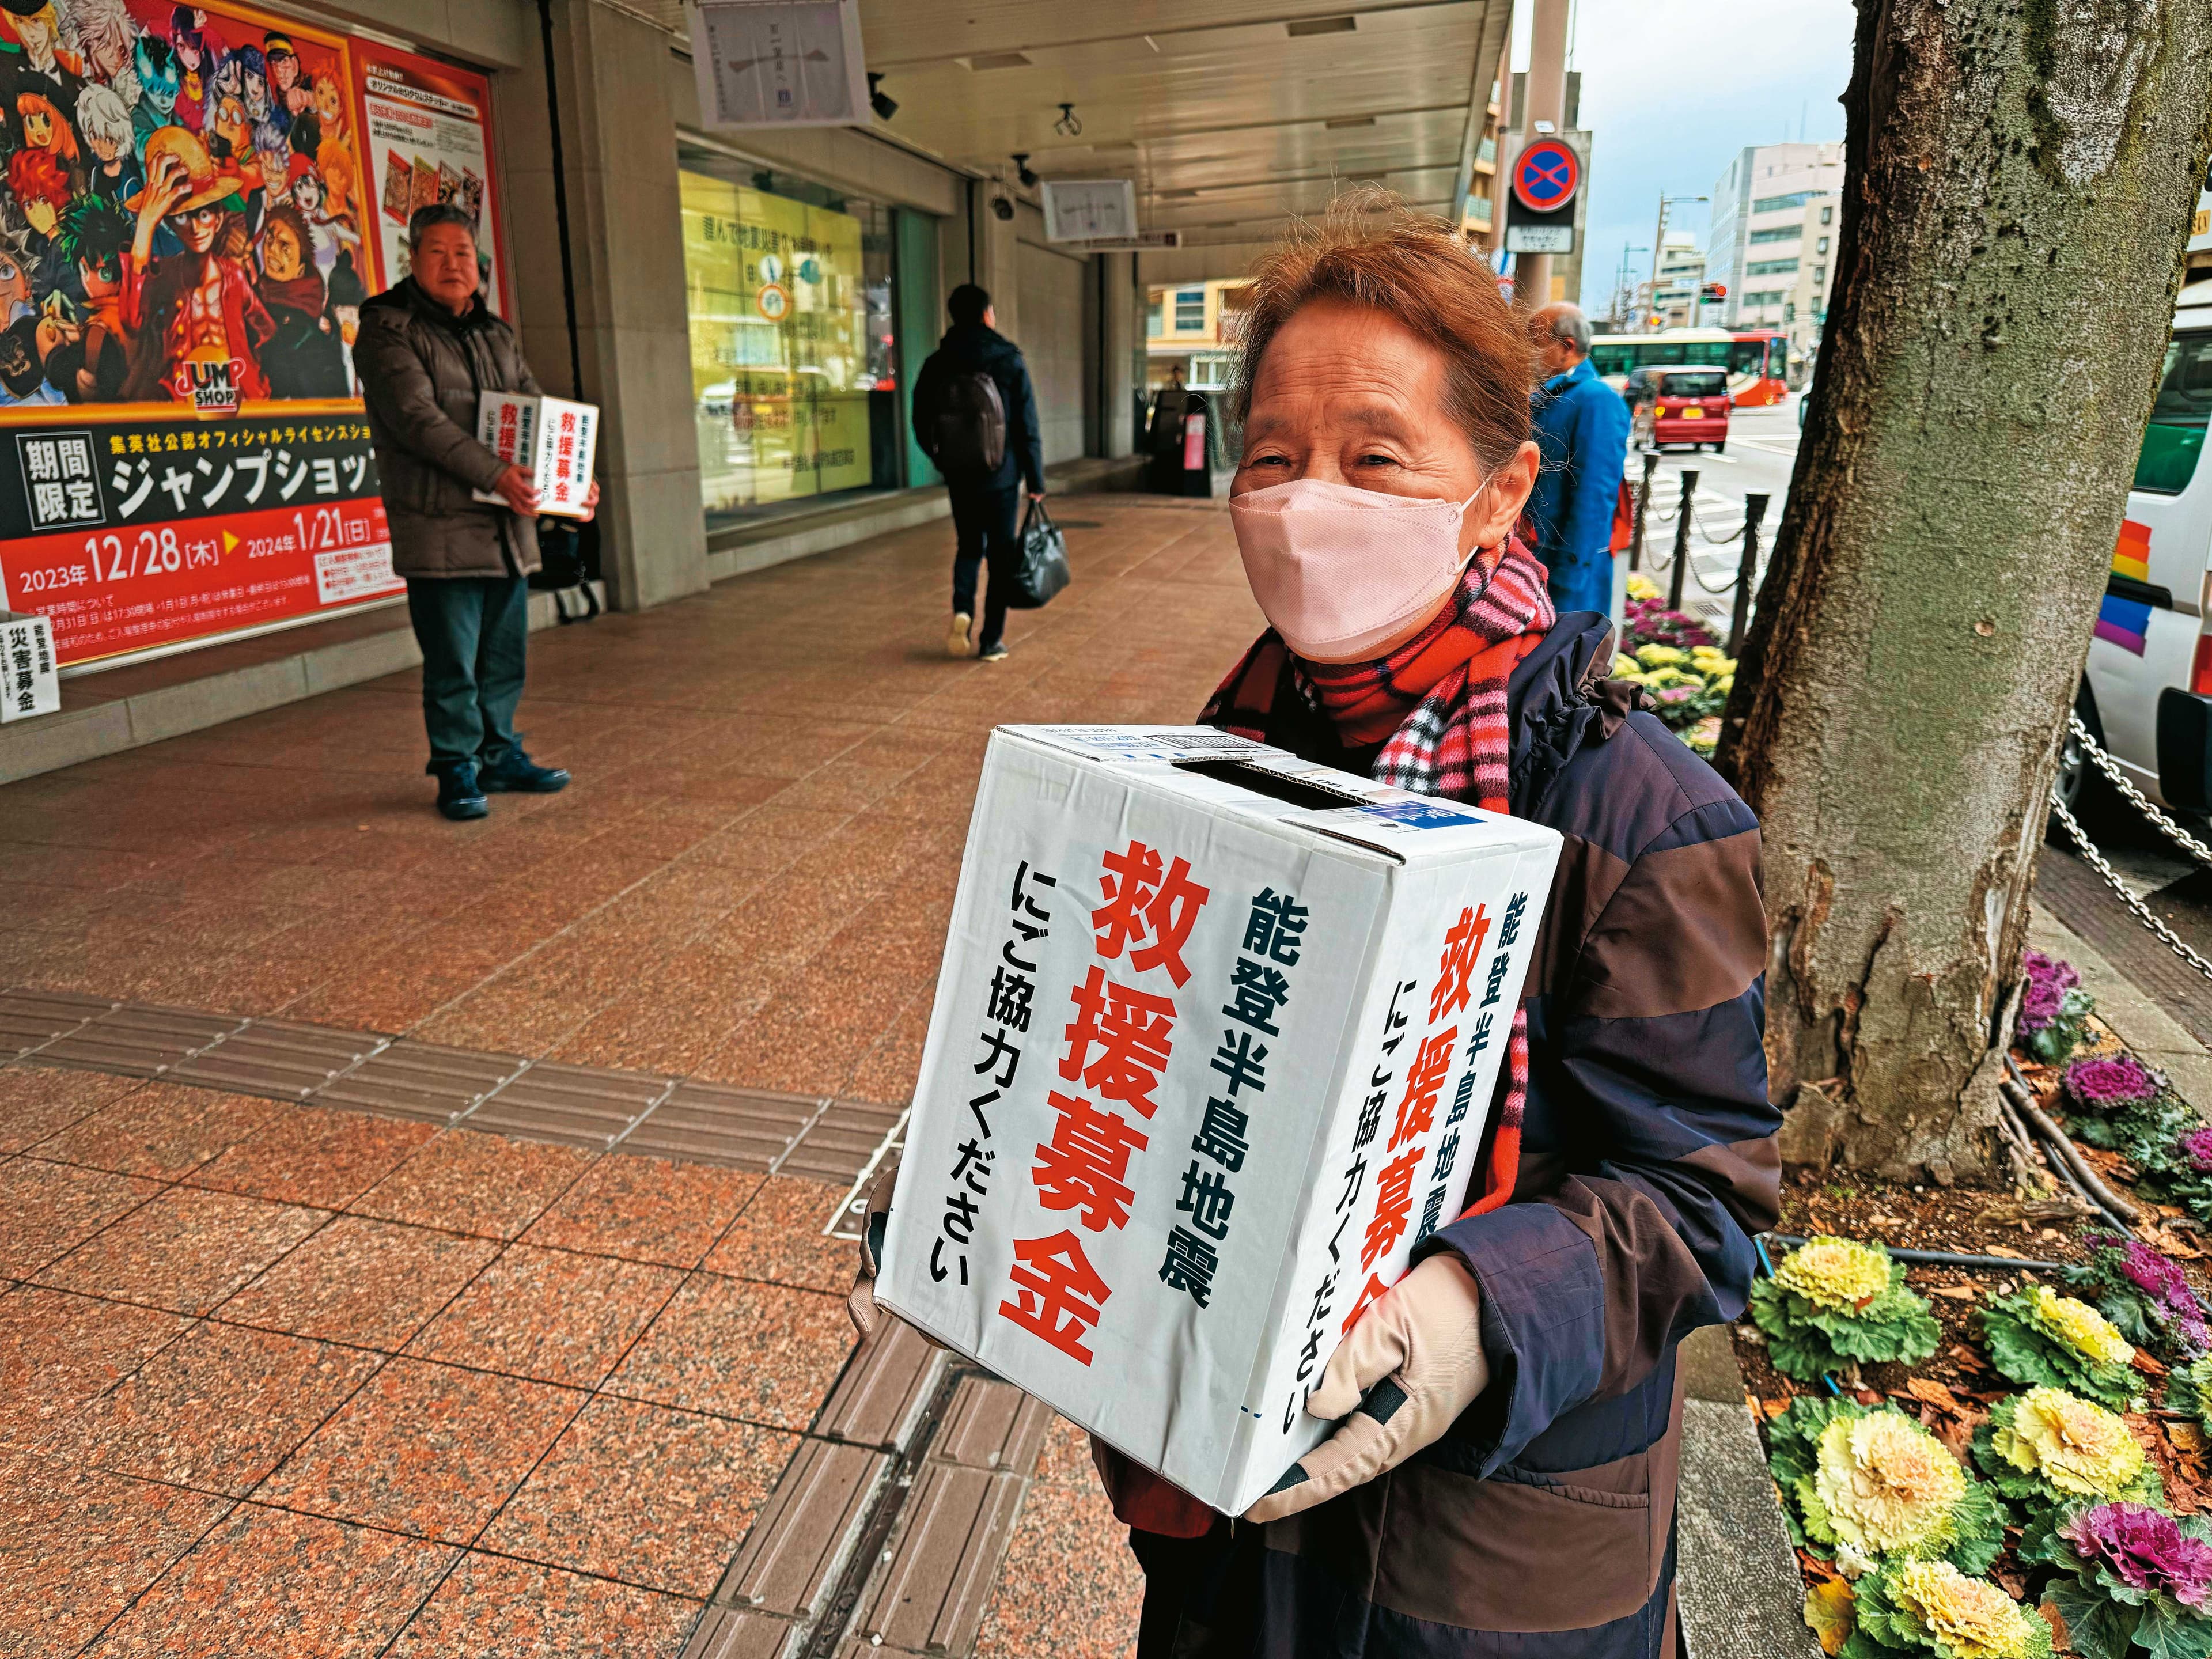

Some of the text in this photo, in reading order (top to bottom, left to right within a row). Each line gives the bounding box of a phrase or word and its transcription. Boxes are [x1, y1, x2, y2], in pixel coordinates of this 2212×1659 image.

[175, 358, 246, 396] JUMP
[195, 391, 233, 405] SHOP
[26, 439, 90, 481] 期間
[34, 480, 98, 522] 限定
[111, 447, 381, 518] ジャンプショッ
[9, 627, 35, 712] 災害募金
[929, 860, 1057, 1286] にご協力ください
[998, 839, 1211, 1368] 救援募金
[1158, 887, 1309, 1310] 能登半島地震
[1415, 891, 1528, 1244] 能登半島地震
[1283, 979, 1417, 1435] にご協力ください
